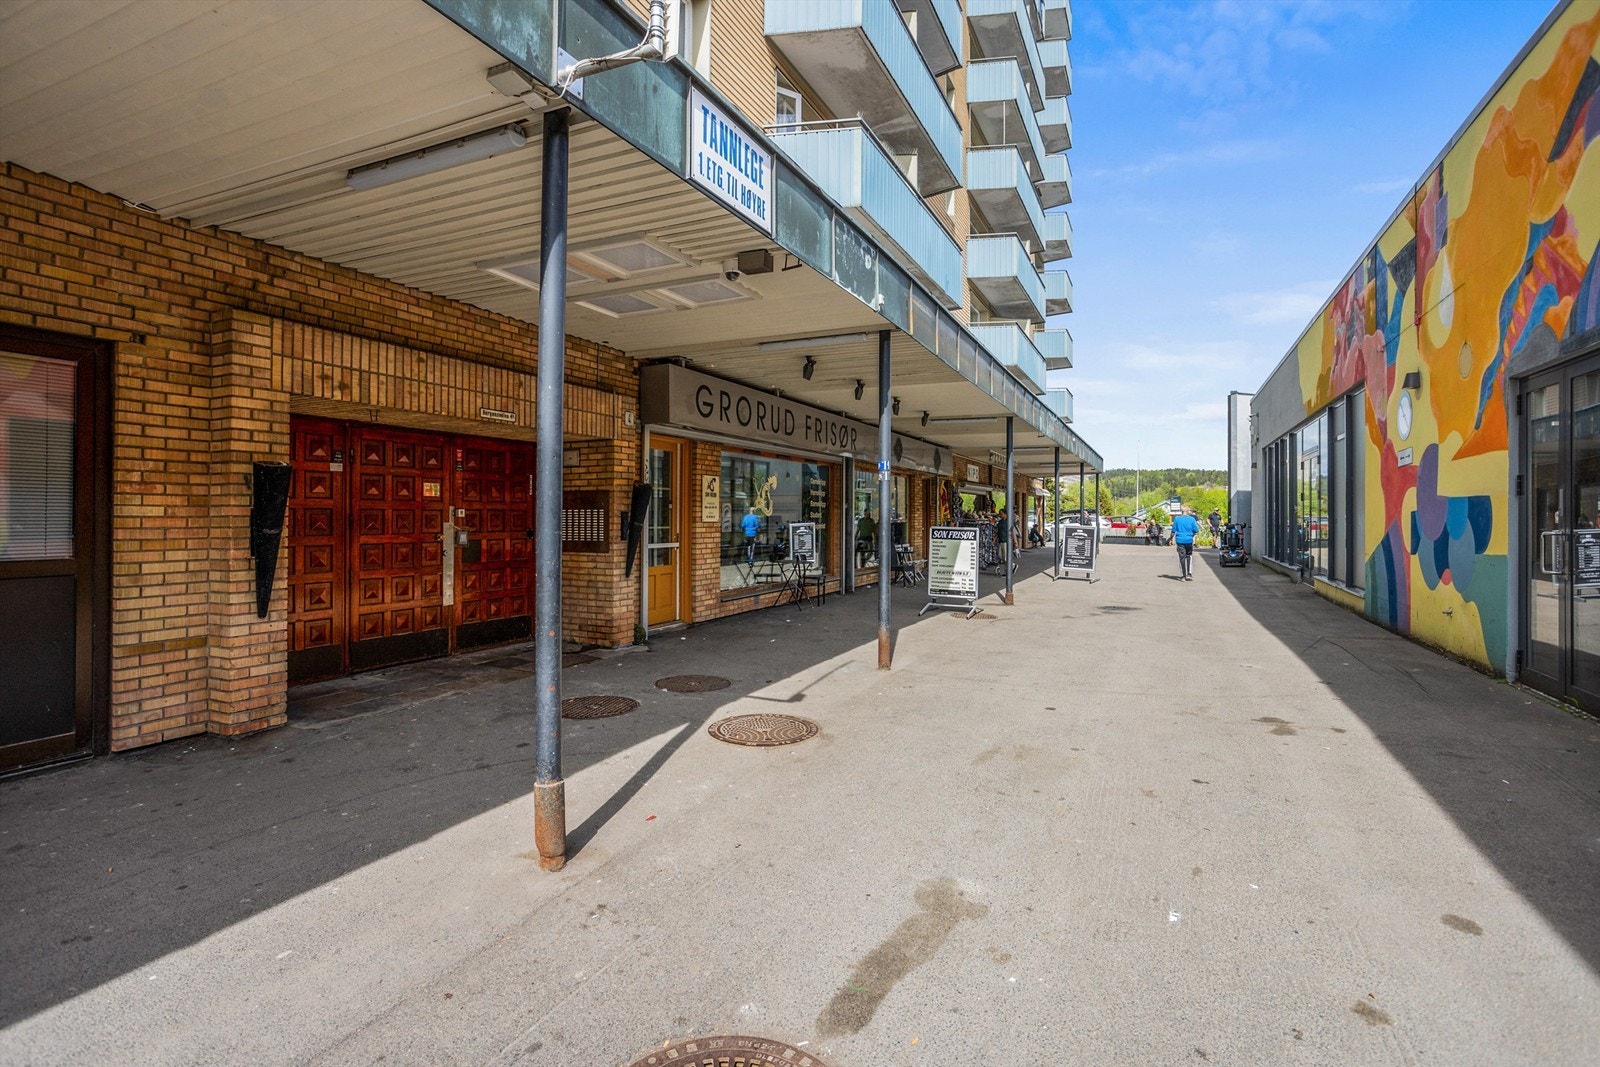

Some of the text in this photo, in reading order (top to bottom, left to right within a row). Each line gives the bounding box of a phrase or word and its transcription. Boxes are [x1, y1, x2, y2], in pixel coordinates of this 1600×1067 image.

[701, 104, 764, 190] TANNLEGE
[698, 152, 766, 221] 1. ETG. TIL HØYRE
[695, 384, 858, 451] GRORUD FRISØR
[932, 530, 975, 540] SON FRISØR
